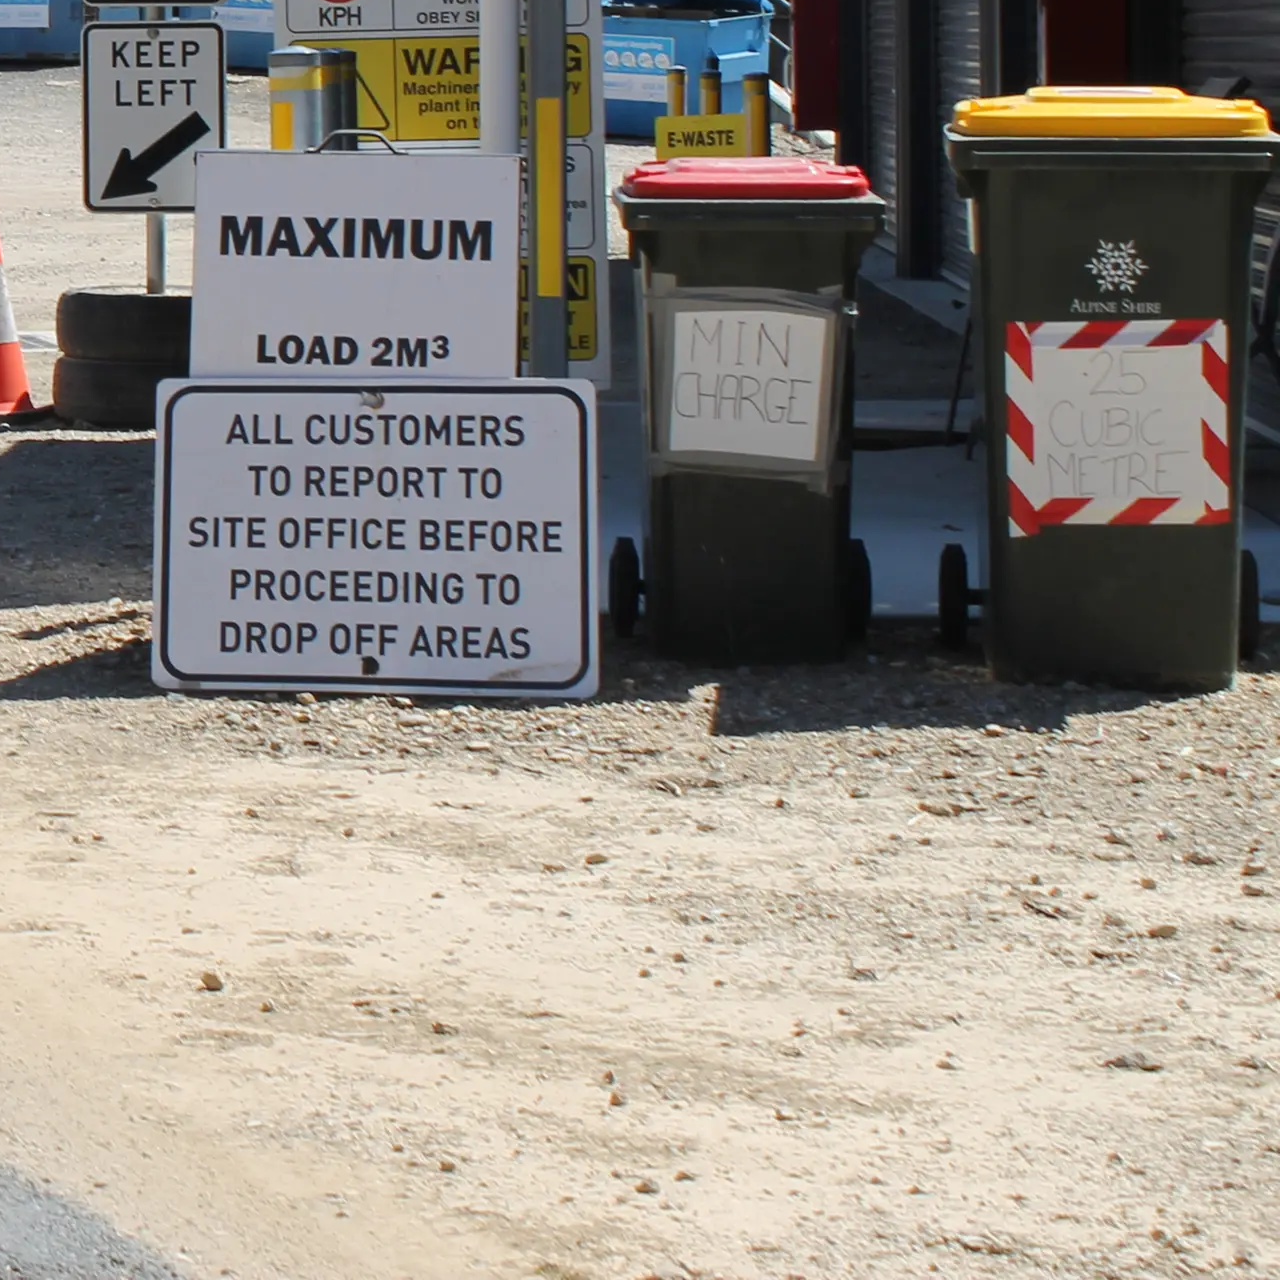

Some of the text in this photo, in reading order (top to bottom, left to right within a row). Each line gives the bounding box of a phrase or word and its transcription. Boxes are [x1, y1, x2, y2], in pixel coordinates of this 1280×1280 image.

[319, 6, 361, 26] KPH
[416, 11, 460, 24] OBEY
[112, 41, 200, 67] KEEP
[116, 80, 196, 106] LEFT
[403, 81, 480, 95] Machiner
[419, 100, 460, 116] plant
[446, 118, 467, 130] on
[667, 130, 734, 148] E-WASTE
[220, 216, 492, 261] MAXIMUM
[257, 334, 359, 366] LOAD
[691, 319, 790, 368] MIN
[675, 372, 812, 425] CHARGE
[226, 414, 525, 447] ALL CUSTOMERS
[1048, 400, 1166, 447] CUBIC
[248, 466, 503, 499] TO REPORT TO
[1047, 451, 1190, 497] METRE
[188, 517, 563, 553] SITE OFFICE BEFORE
[230, 570, 521, 606] PROCEEDING TO
[220, 622, 532, 660] DROP OFF AREAS
